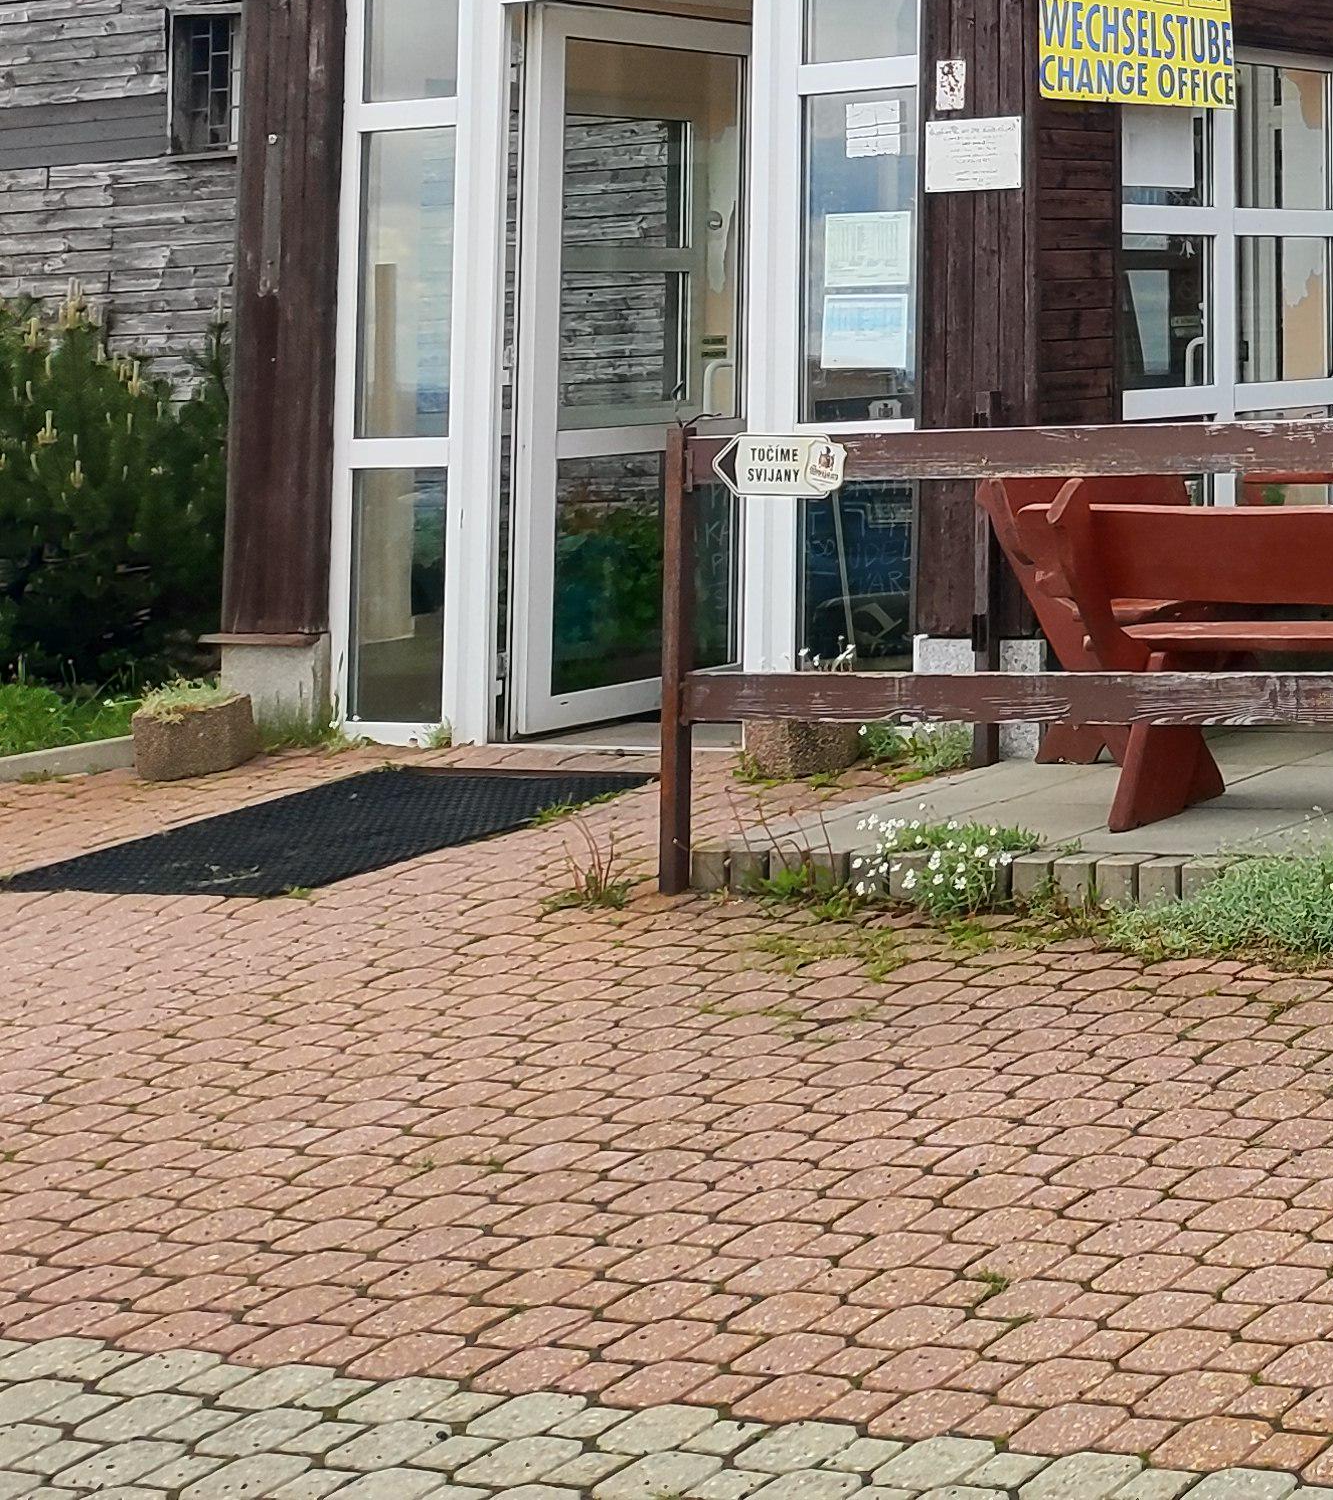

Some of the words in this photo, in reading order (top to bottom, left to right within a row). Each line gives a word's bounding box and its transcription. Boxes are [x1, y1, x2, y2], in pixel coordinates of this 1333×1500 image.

[1040, 54, 1149, 98] CHANGE
[1157, 62, 1235, 106] OFFICE
[750, 444, 799, 462] TOČÍME
[747, 467, 800, 483] SVIJANY
